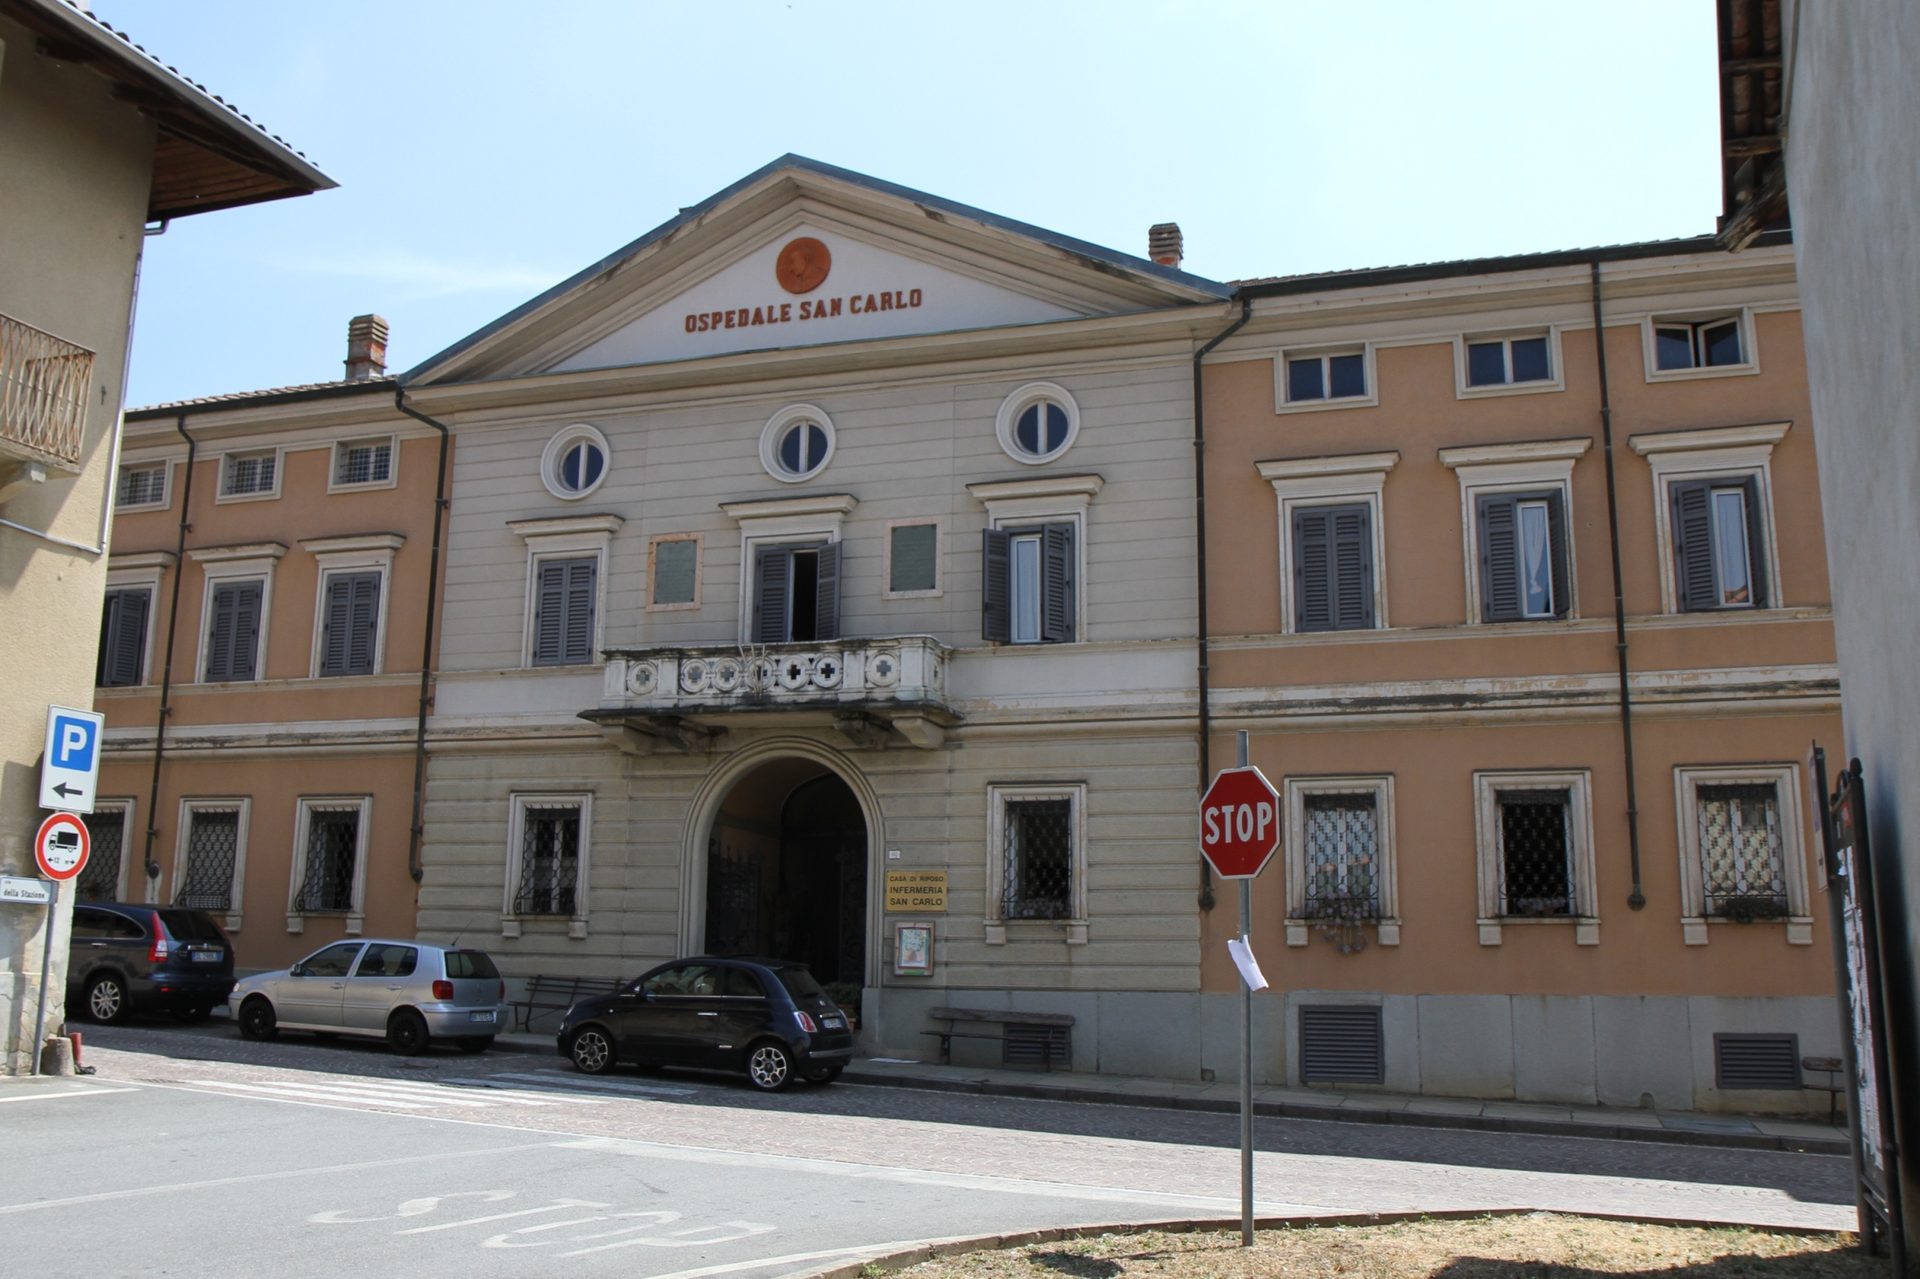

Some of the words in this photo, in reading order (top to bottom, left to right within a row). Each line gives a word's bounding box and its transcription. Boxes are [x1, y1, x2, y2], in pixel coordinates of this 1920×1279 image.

[685, 303, 792, 333] OSPEDALE
[799, 297, 843, 321] SAN
[849, 288, 922, 314] CARLO
[60, 724, 88, 762] P
[1205, 802, 1272, 845] STOP
[3, 889, 19, 897] della
[21, 889, 45, 899] Stazione
[889, 886, 943, 894] INFERMERIA
[889, 898, 908, 906] SAN
[912, 898, 943, 906] CARLO
[304, 1188, 777, 1259] STOP
